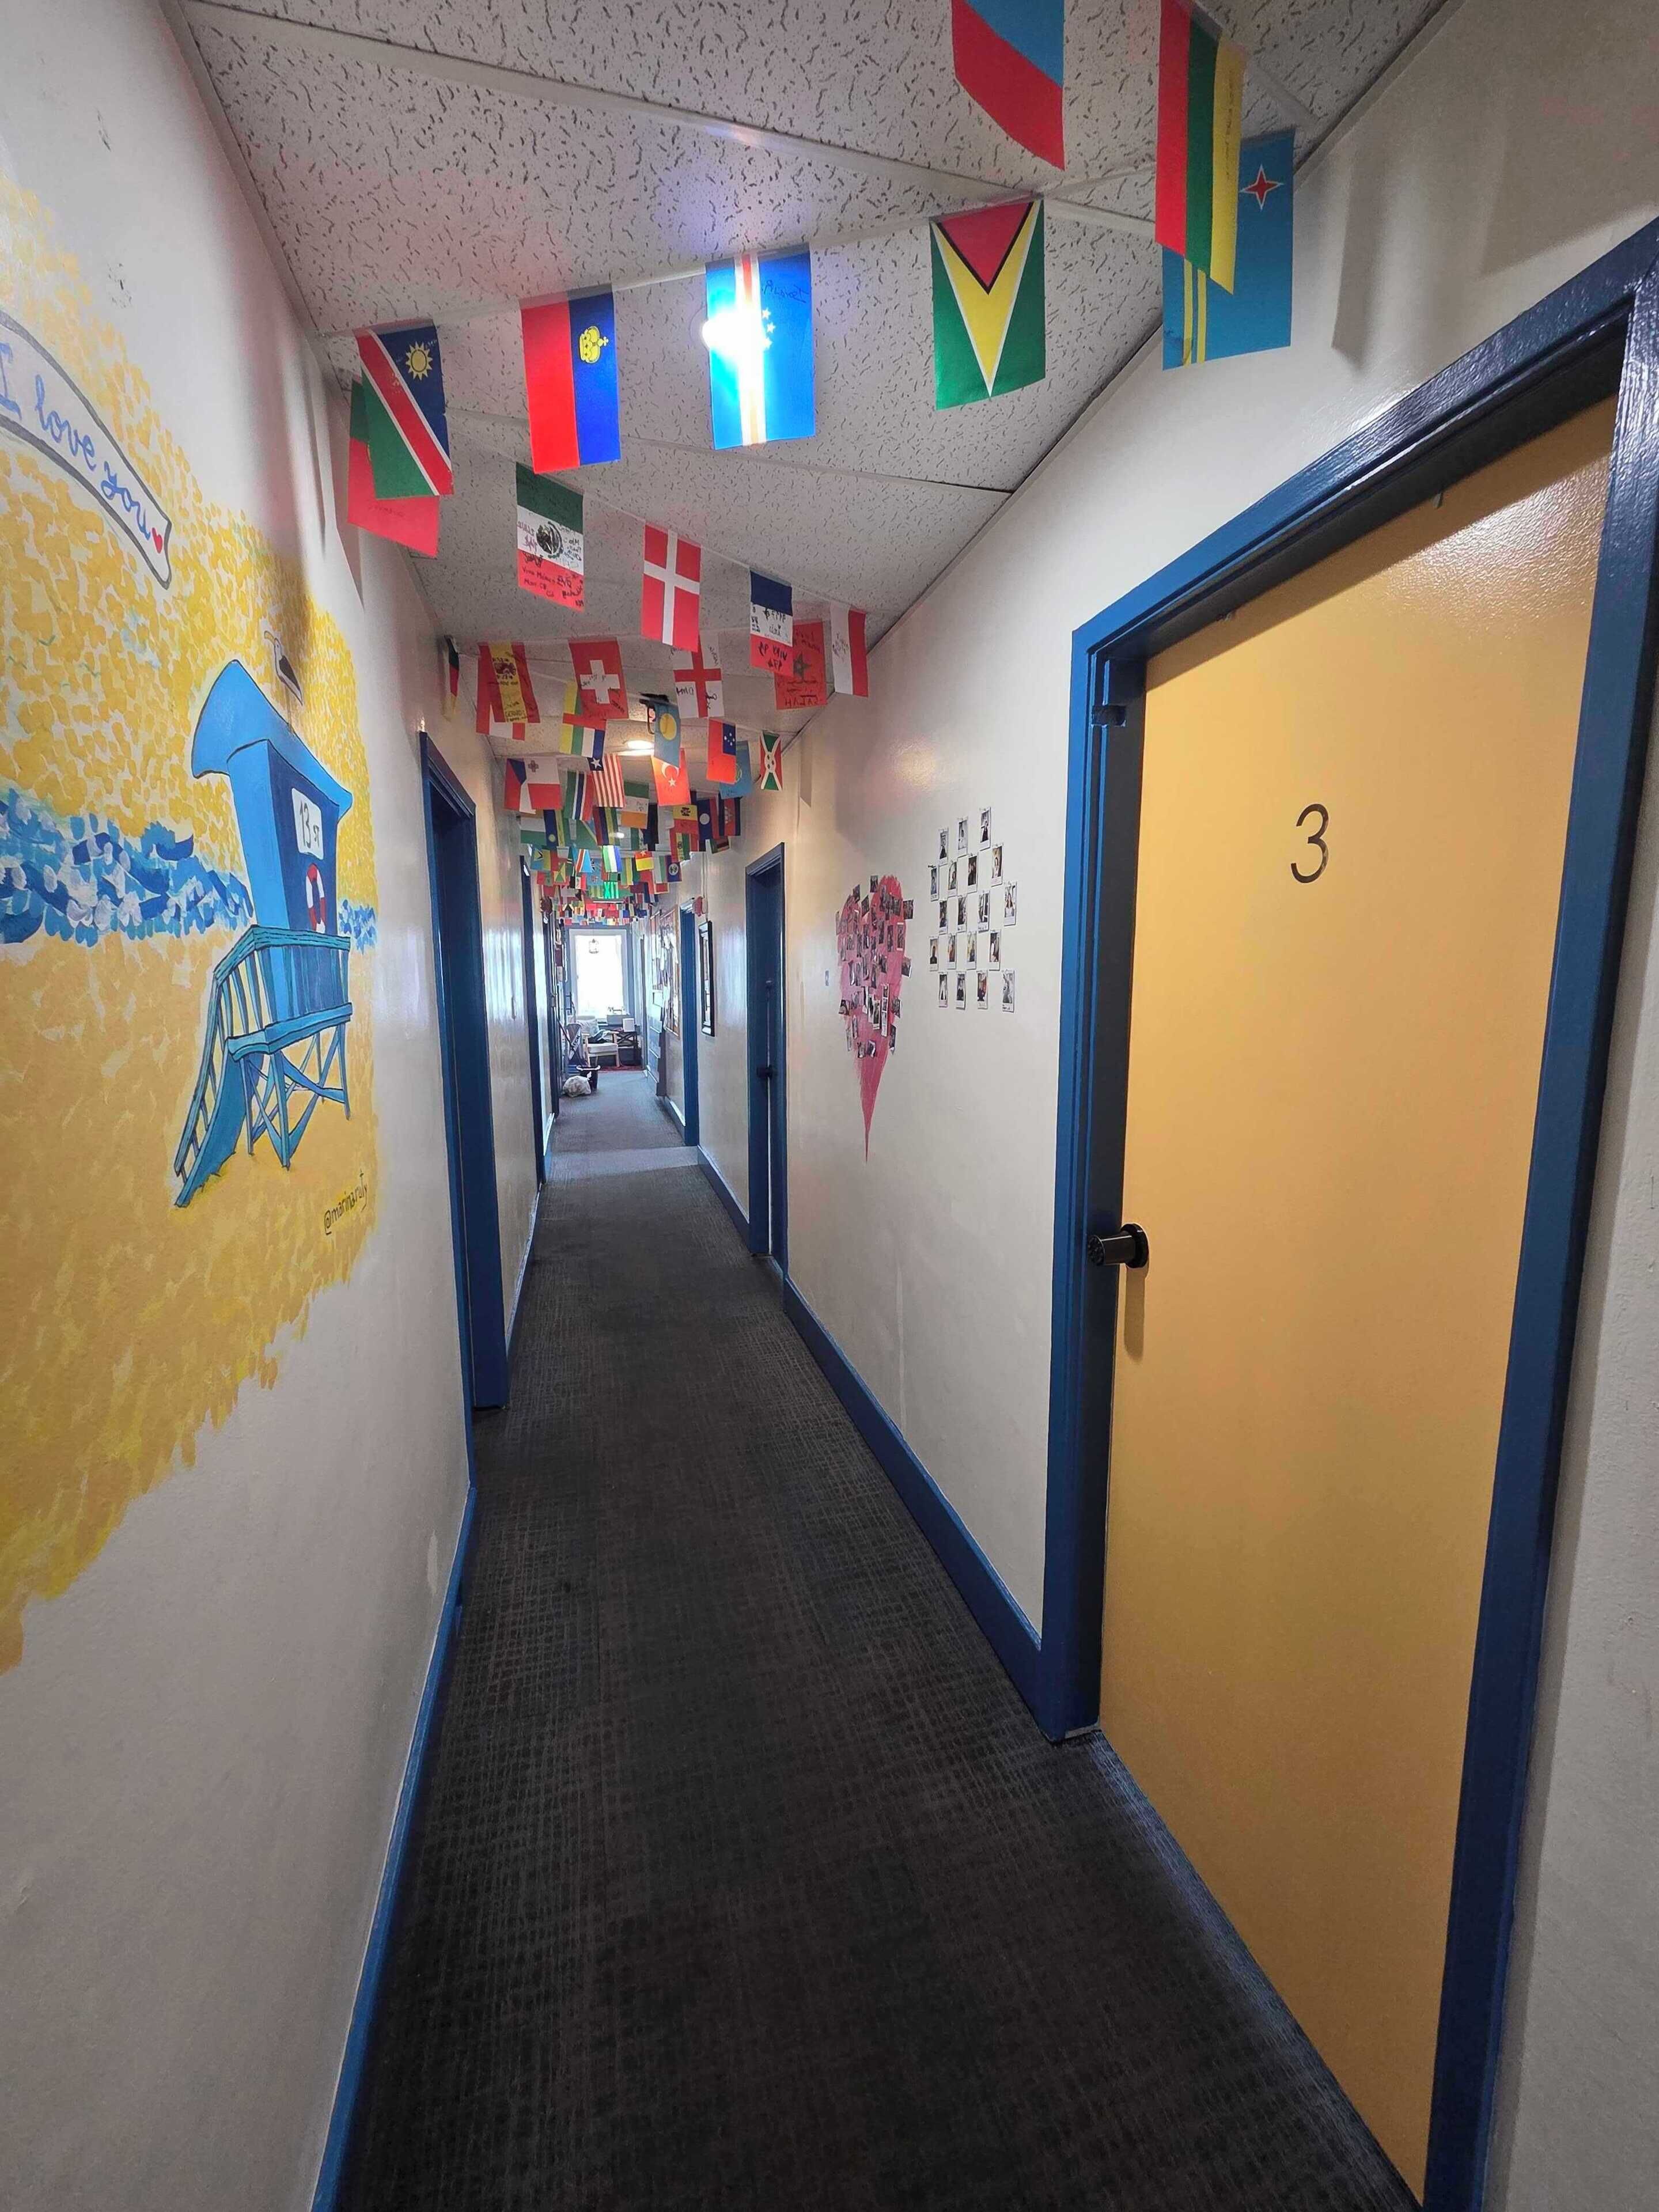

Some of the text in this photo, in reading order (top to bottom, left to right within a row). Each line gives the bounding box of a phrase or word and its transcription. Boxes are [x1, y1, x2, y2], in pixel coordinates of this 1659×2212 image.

[35, 373, 97, 471] love
[100, 461, 151, 540] you
[300, 800, 312, 849] 13
[1291, 804, 1329, 884] 3
